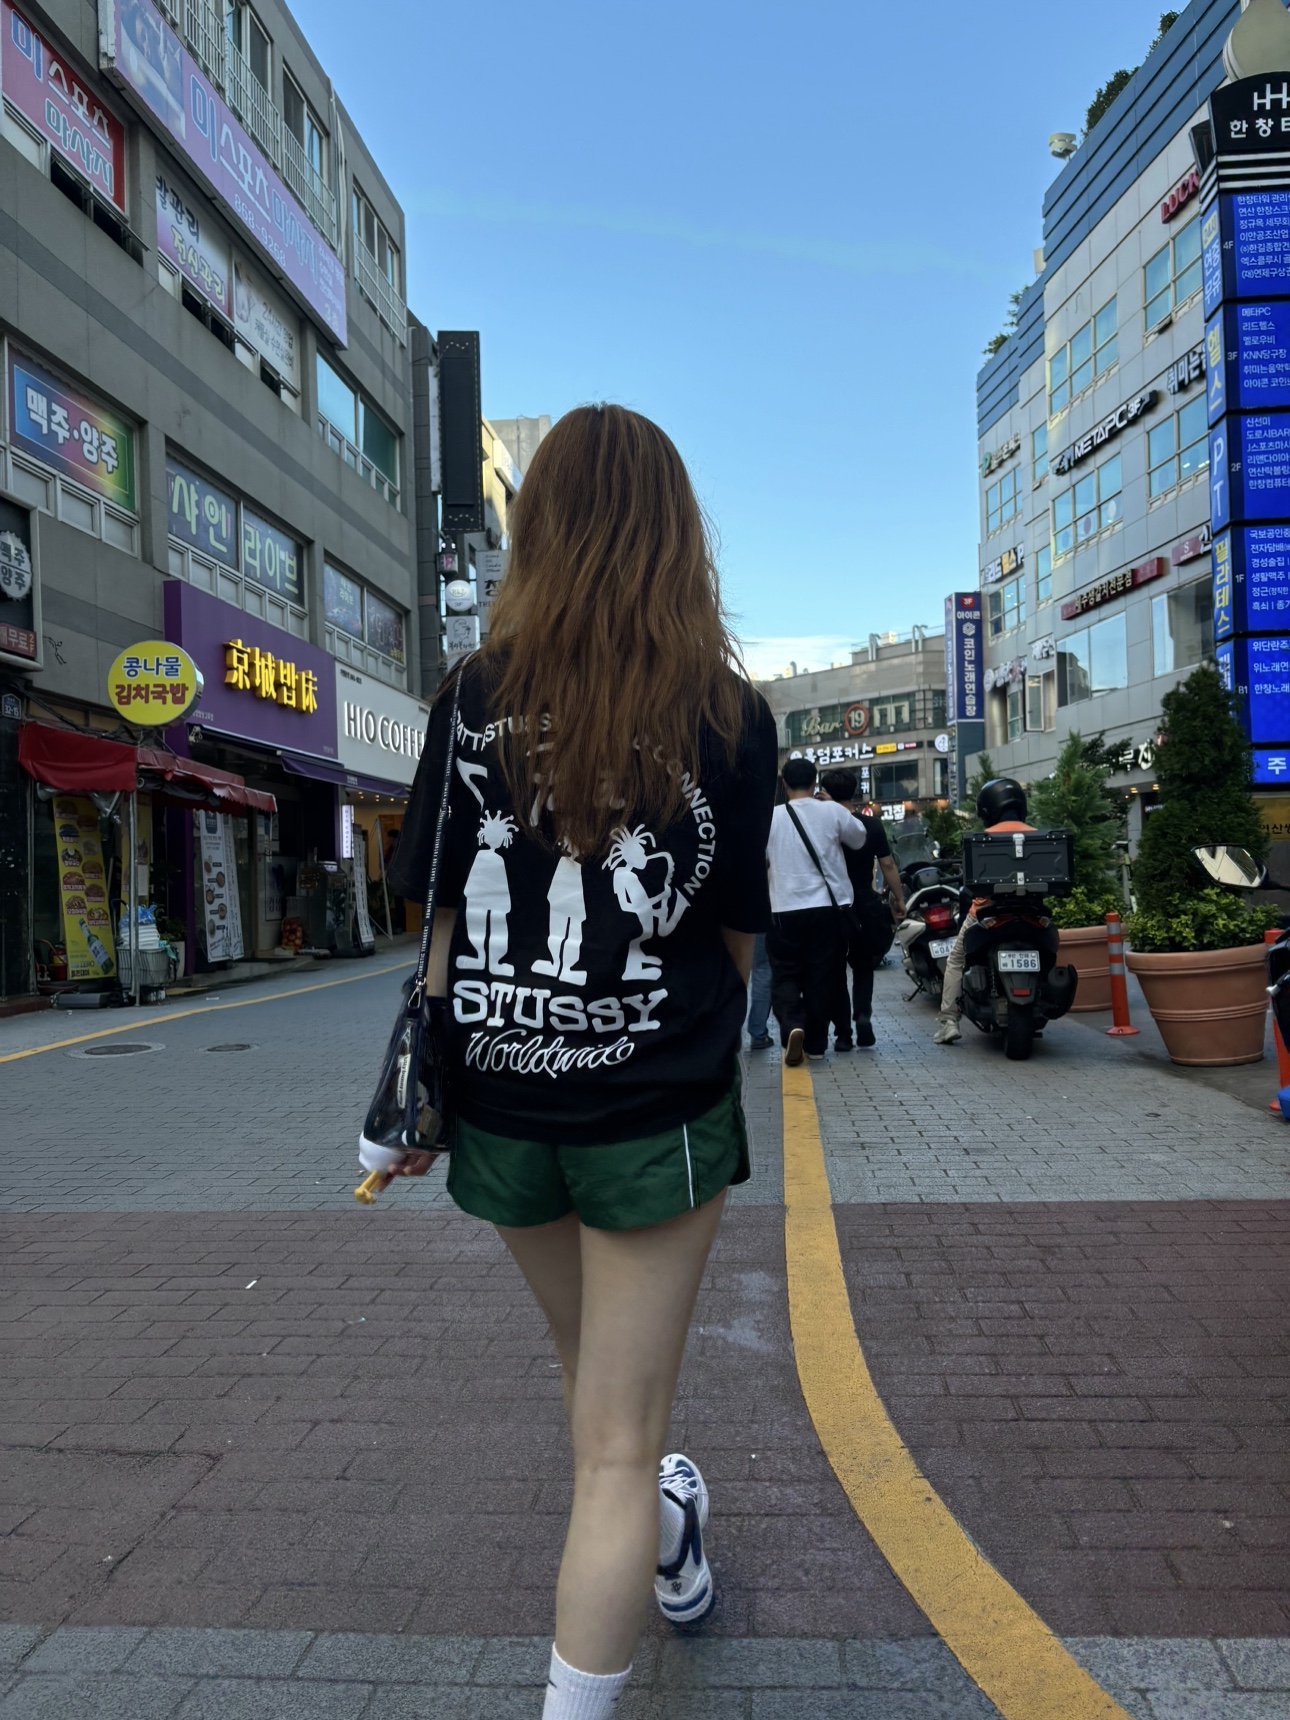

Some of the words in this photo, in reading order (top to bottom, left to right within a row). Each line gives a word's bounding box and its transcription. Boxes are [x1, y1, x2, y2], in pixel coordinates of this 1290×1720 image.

[11, 8, 43, 82] 미
[47, 59, 110, 149] 스포츠
[190, 73, 217, 163] 미
[45, 98, 114, 196] 마사지
[220, 123, 271, 223] 스포츠
[1237, 194, 1270, 205] 한창타워
[1271, 193, 1290, 203] 관리
[1256, 205, 1290, 216] 한창스크
[272, 189, 318, 285] 마사지
[1223, 241, 1234, 250] 4F
[1241, 307, 1271, 317] 메타PC
[1227, 351, 1238, 360] 3F
[1243, 349, 1287, 360] KNN당구장
[1207, 323, 1222, 412] 헬스
[1243, 378, 1269, 388] 아이콘
[1073, 404, 1128, 461] METAPC
[1231, 463, 1241, 472] 2F
[243, 520, 299, 596] 라이브
[1215, 537, 1230, 633] 필라테스
[1235, 574, 1244, 583] 1F
[957, 611, 981, 620] 아이콘
[1252, 640, 1290, 652] 위단란주
[122, 656, 182, 678] 콩나물
[963, 638, 977, 717] 코인노래연습장
[114, 683, 189, 708] 김치국밥
[1238, 686, 1248, 694] B1
[344, 701, 376, 745] HIO
[801, 715, 842, 737] Bar
[849, 709, 865, 728] 19
[1011, 959, 1037, 968] 1586
[453, 980, 668, 1033] STUSSY
[465, 1029, 635, 1079] Worldwide
